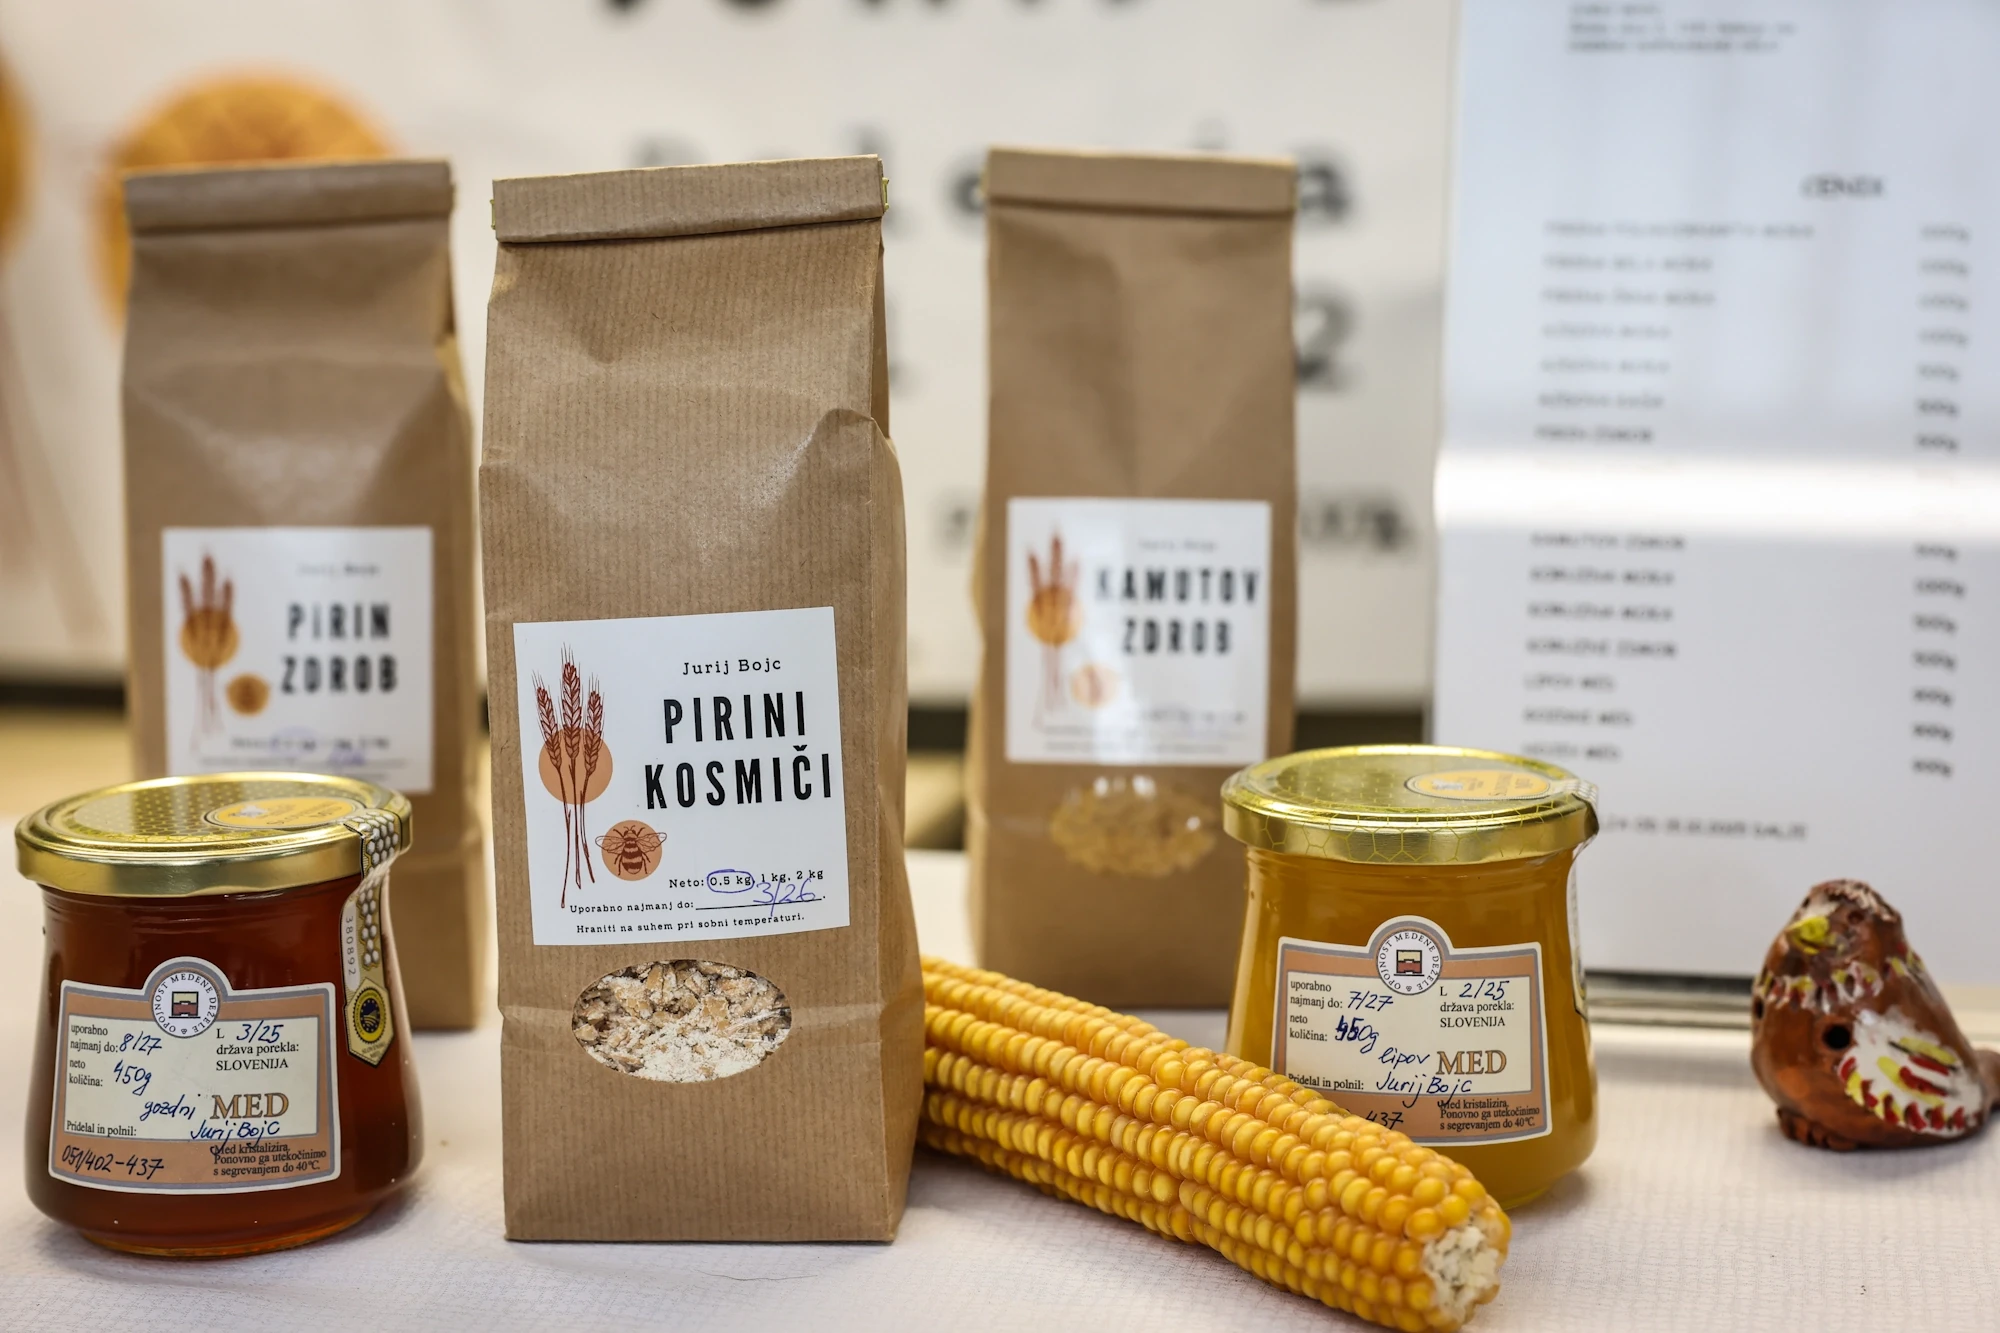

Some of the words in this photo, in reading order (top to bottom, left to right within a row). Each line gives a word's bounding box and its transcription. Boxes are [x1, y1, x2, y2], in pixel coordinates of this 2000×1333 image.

[288, 602, 390, 640] PIRIN
[1122, 618, 1231, 656] ZDROB
[281, 654, 397, 695] ZDROB
[683, 660, 729, 675] Jurij
[738, 658, 781, 673] Bojc
[663, 691, 805, 744] PIRINI
[645, 744, 831, 810] KOSMIČI
[669, 878, 705, 889] Neto:
[796, 870, 803, 880] 2
[808, 869, 824, 880] kg
[753, 877, 816, 917] 3/26
[570, 904, 623, 914] Uporabno
[627, 901, 673, 912] najmanj
[677, 900, 694, 910] do:
[576, 923, 616, 934] Hraniti
[620, 924, 633, 933] na
[637, 921, 673, 932] suhem
[677, 920, 694, 931] pri
[698, 918, 729, 929] sobni
[733, 912, 805, 926] temperaturi.
[345, 915, 357, 976] 380892
[1394, 932, 1436, 953] MEDENE
[170, 973, 213, 994] MEDENE
[1290, 980, 1332, 992] uporabno
[1440, 986, 1448, 997] L
[1459, 979, 1510, 1001] 2/25
[1290, 995, 1325, 1010] najmanj
[1327, 997, 1343, 1009] do:
[1347, 990, 1394, 1012] 7/27
[1440, 1001, 1474, 1013] država
[1476, 1000, 1515, 1014] porekla:
[1289, 1014, 1308, 1024] neto
[1440, 1016, 1506, 1028] SLOVENIJA
[71, 1023, 108, 1036] uporabno
[216, 1027, 225, 1039] L
[236, 1020, 284, 1043] 3/25
[1289, 1027, 1328, 1042] količina:
[70, 1038, 102, 1054] najmanj
[103, 1041, 119, 1053] do:
[119, 1030, 162, 1056] 8/27
[216, 1043, 253, 1055] država
[256, 1041, 299, 1056] porekla:
[69, 1059, 86, 1069] neto
[216, 1057, 289, 1072] SLOVENIJA
[1378, 1046, 1431, 1070] lipov
[1435, 1049, 1508, 1075] MED
[68, 1072, 103, 1087] količina:
[113, 1059, 152, 1097] 450g
[1322, 1077, 1331, 1088] in
[1333, 1079, 1365, 1090] polnil:
[1376, 1071, 1427, 1108] Jurij
[139, 1093, 201, 1121] gozdni
[209, 1092, 290, 1120] MED
[1440, 1109, 1480, 1119] Ponovno
[1481, 1111, 1492, 1121] ga
[66, 1120, 95, 1133] Pridelal
[97, 1124, 106, 1135] in
[107, 1126, 137, 1138] polnil:
[1440, 1121, 1445, 1130] s
[1447, 1120, 1501, 1132] segrevanjem
[1502, 1118, 1513, 1128] do
[190, 1119, 236, 1156] Jurij
[214, 1153, 256, 1165] Ponovno
[258, 1155, 270, 1165] ga
[272, 1148, 327, 1161] utekočinimo
[213, 1167, 219, 1176] s
[221, 1163, 280, 1177] segrevanjem
[282, 1162, 294, 1173] do
